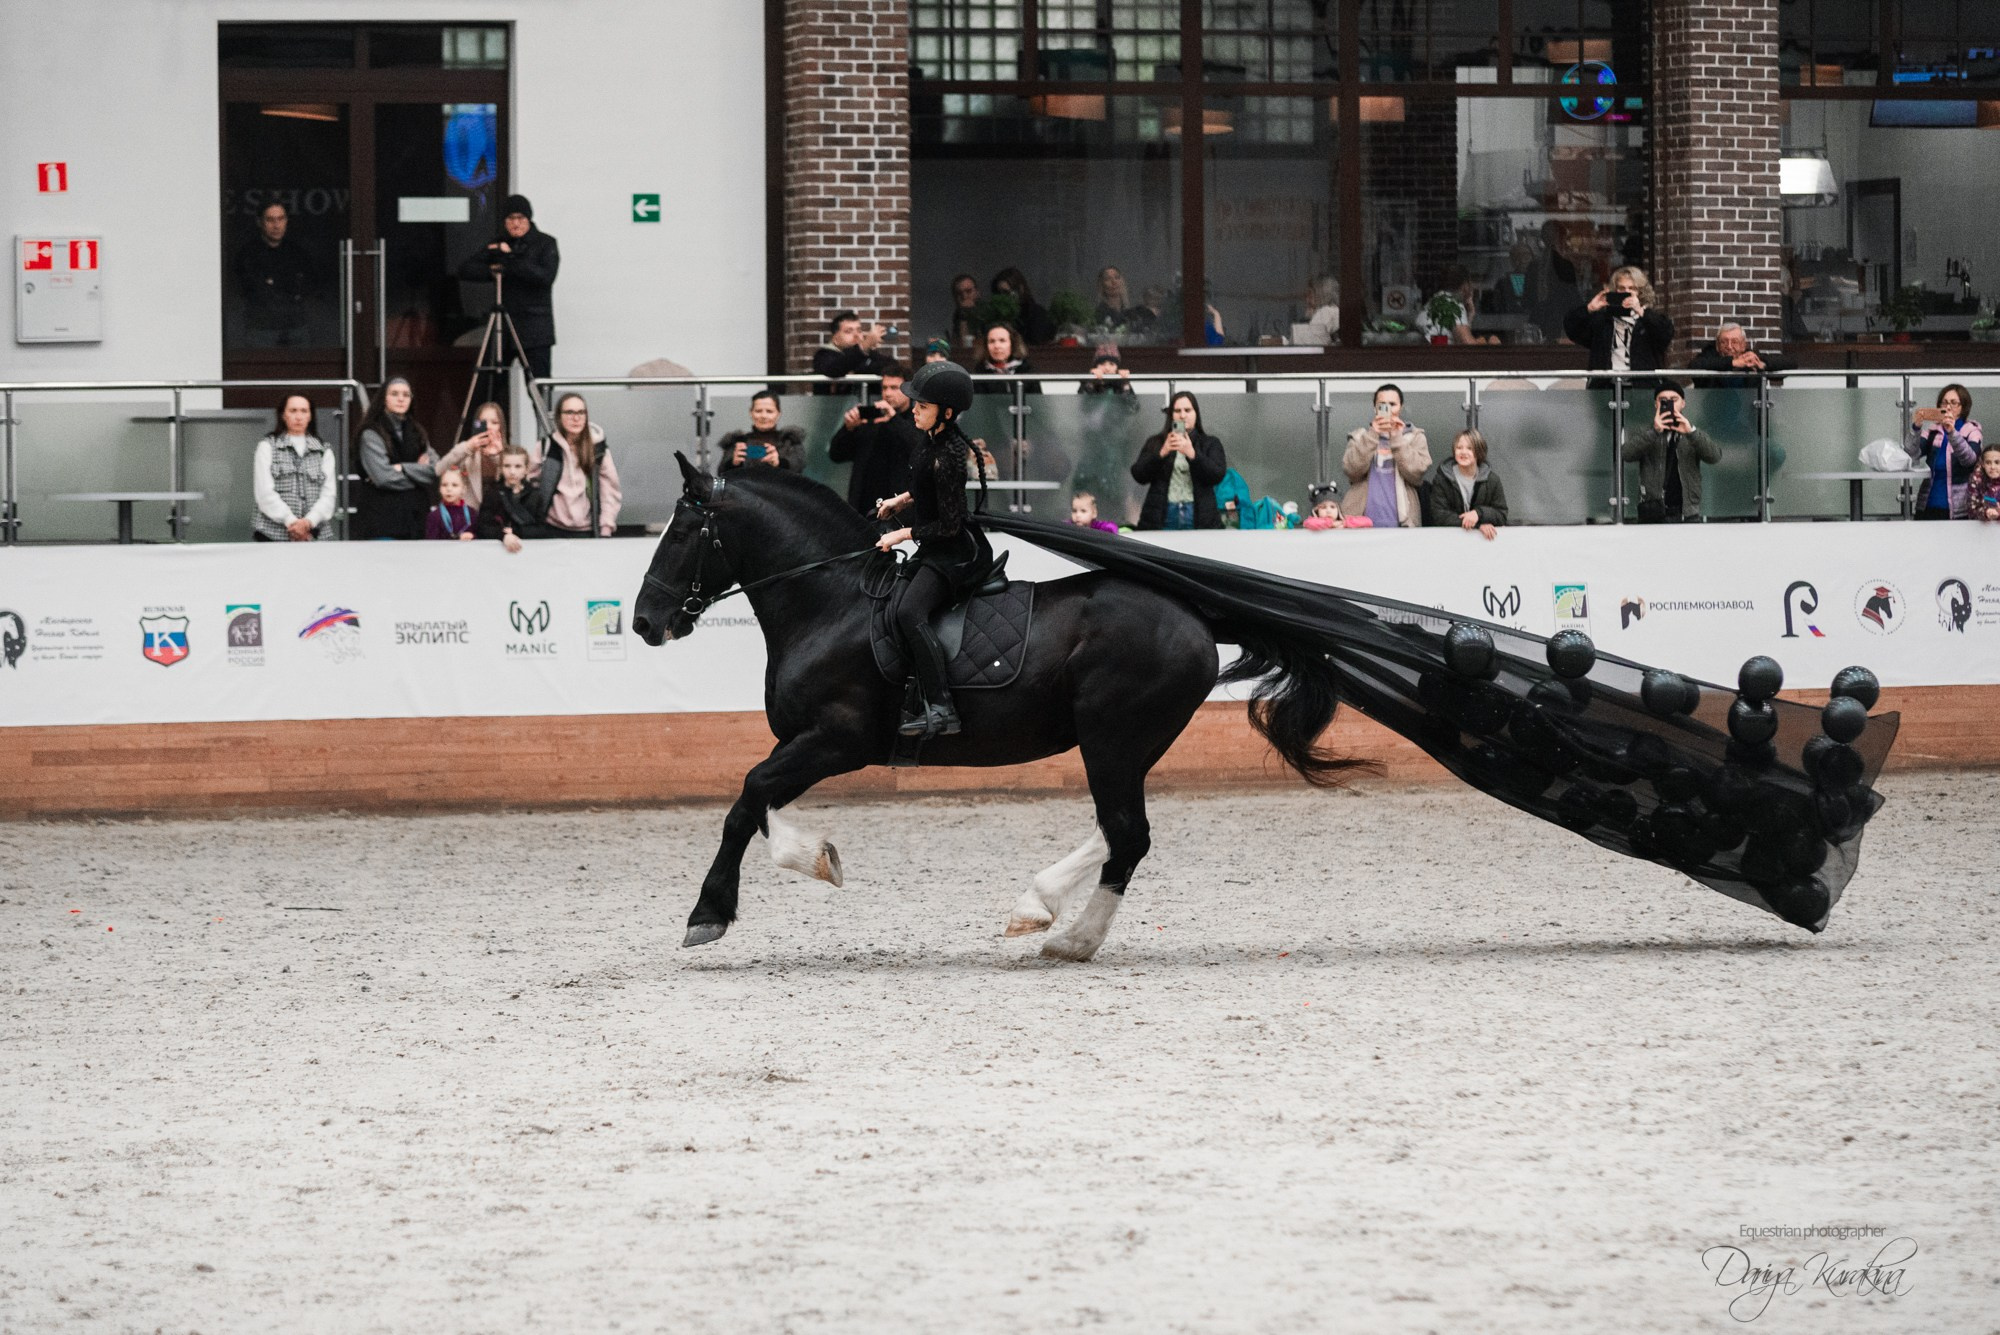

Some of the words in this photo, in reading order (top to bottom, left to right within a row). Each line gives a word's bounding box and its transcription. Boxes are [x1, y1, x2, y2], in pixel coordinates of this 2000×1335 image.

[1649, 600, 1754, 611] РОСПЛЕМКОНЗАВОД
[395, 620, 468, 630] КРЫЛАТЫЙ
[396, 631, 470, 644] ЭКЛИПС
